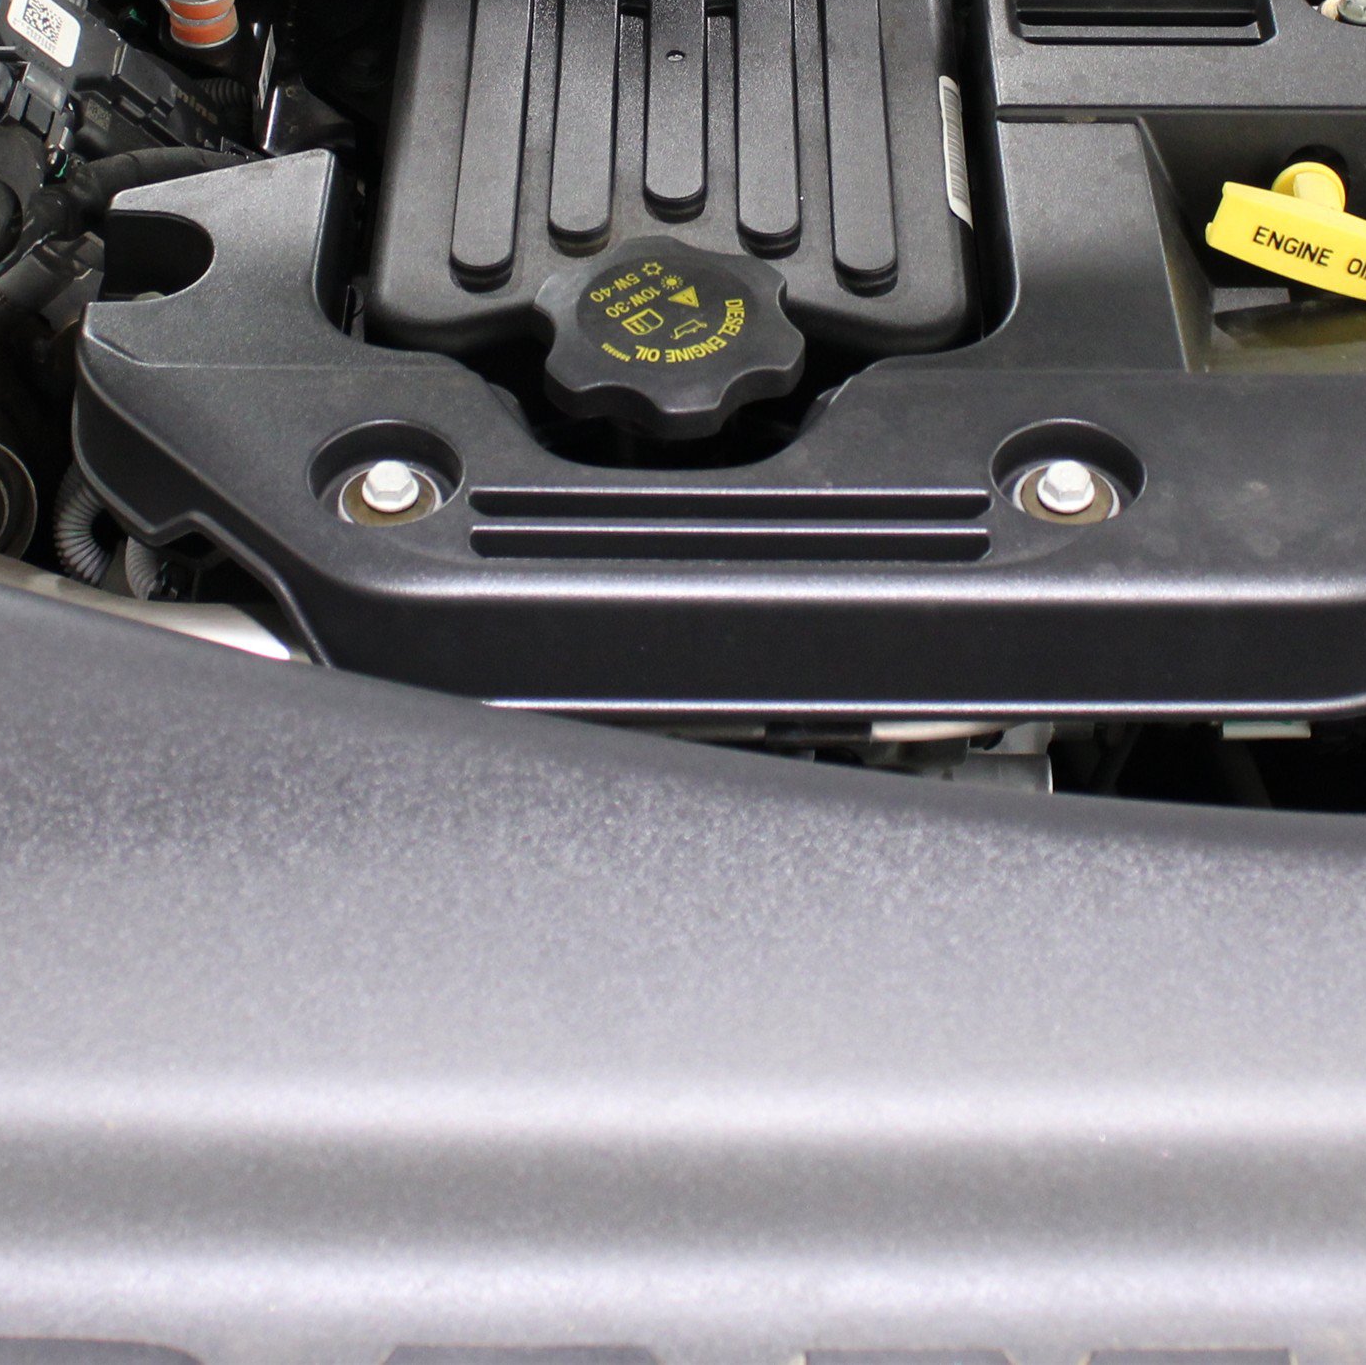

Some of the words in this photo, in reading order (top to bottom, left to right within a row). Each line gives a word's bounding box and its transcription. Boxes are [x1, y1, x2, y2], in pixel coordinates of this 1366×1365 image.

[1252, 225, 1334, 267] ENGINE
[589, 272, 641, 304] 5W-40
[605, 286, 663, 319] 10W-30
[719, 298, 745, 337] DIESEL
[635, 344, 660, 363] OIL
[665, 334, 728, 364] ENGINE
